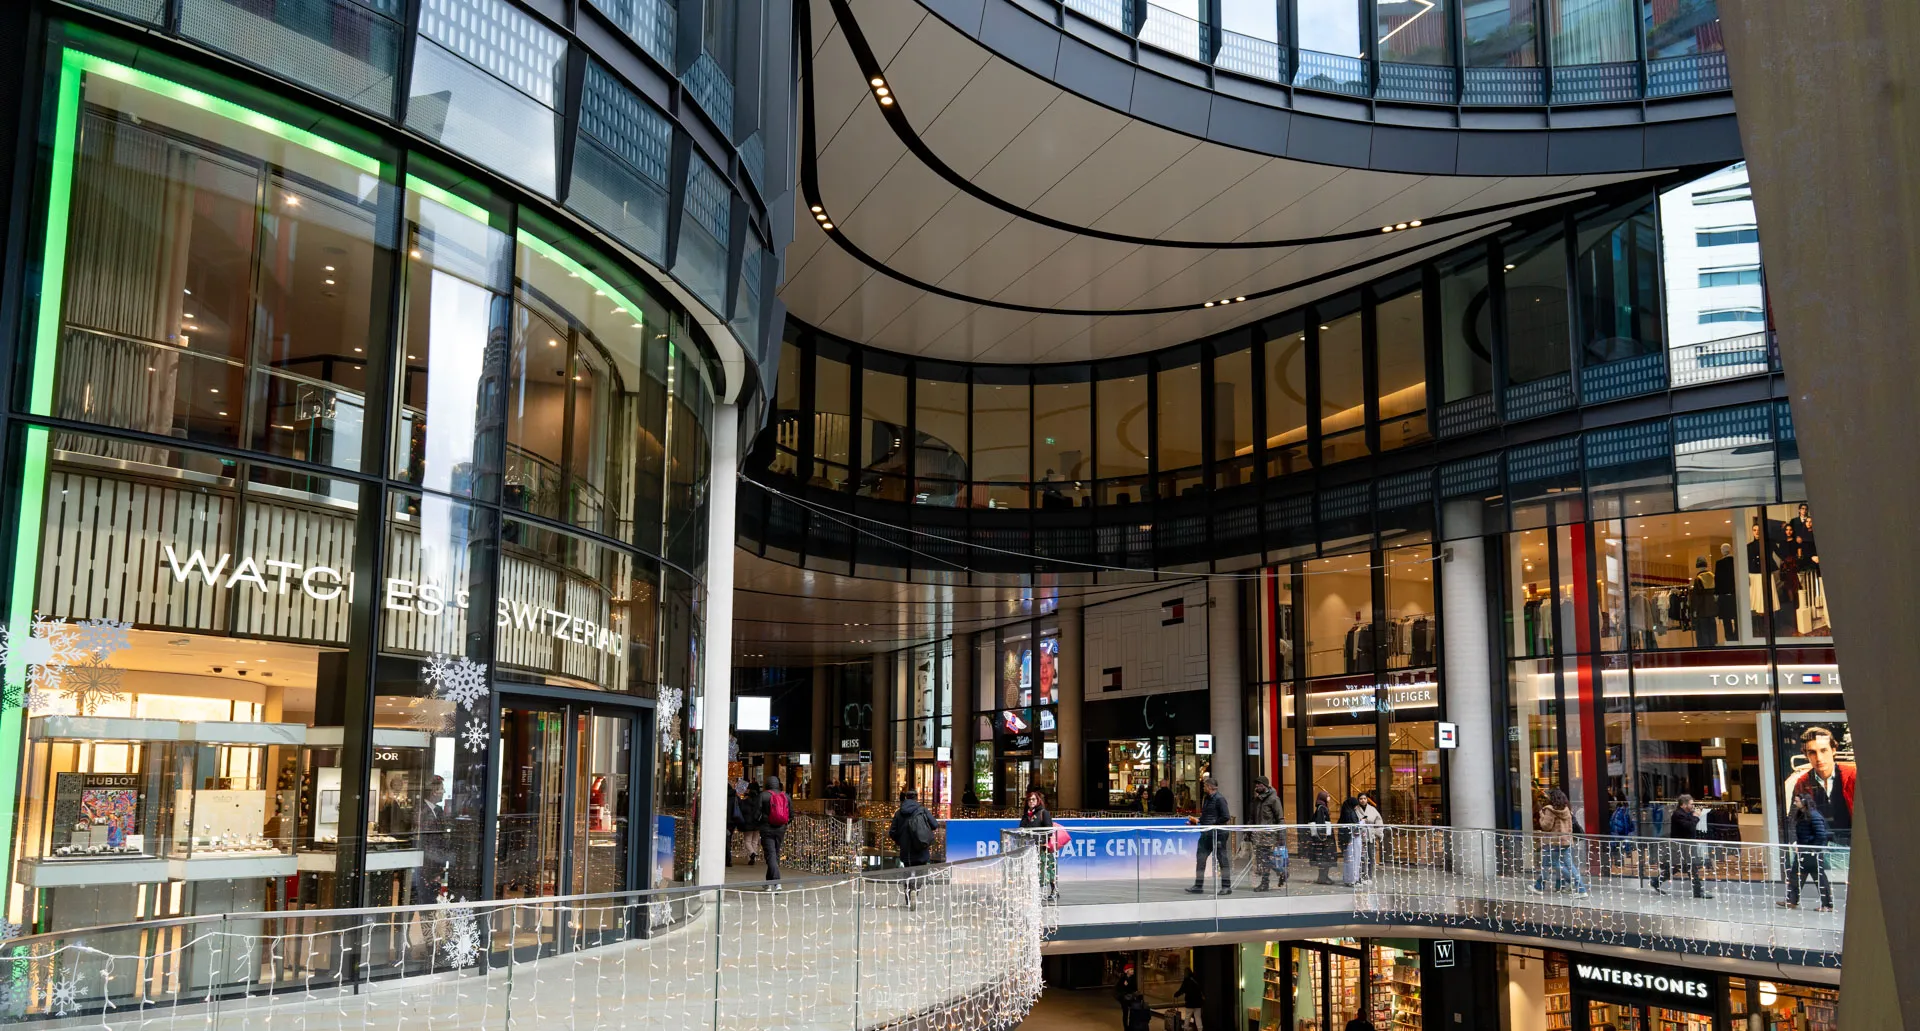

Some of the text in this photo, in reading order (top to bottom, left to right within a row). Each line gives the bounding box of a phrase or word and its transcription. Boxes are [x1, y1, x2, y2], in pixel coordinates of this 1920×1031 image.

[164, 546, 445, 616] WATCES
[498, 597, 622, 657] SWITZERLAND
[1710, 673, 1794, 686] TOMY
[1326, 690, 1431, 708] TOMMY ILFIGER
[86, 777, 136, 785] HUBLOT
[1106, 838, 1187, 856] CENTRAL
[1577, 963, 1708, 998] WATERSTONES
